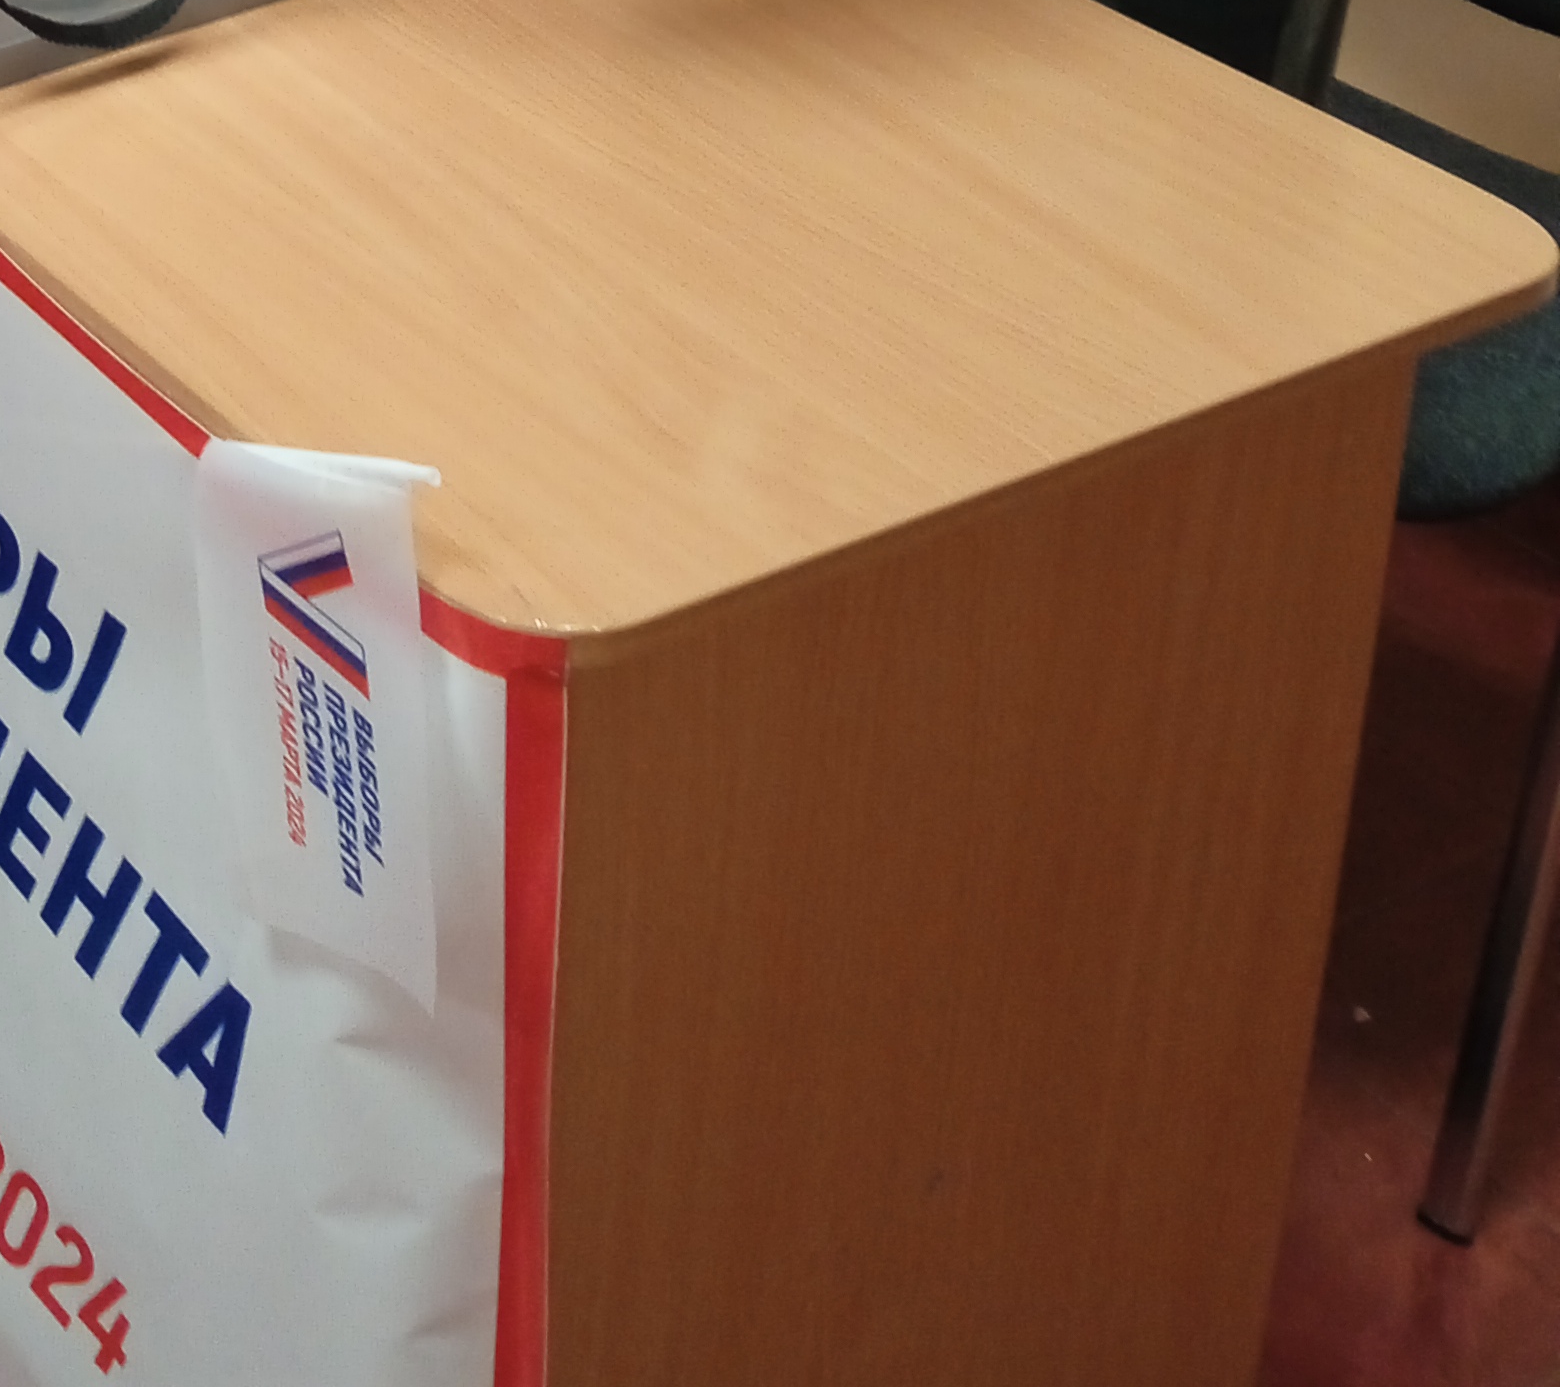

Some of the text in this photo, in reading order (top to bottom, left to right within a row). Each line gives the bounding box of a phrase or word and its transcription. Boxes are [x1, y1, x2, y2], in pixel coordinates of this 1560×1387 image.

[276, 700, 302, 789] МАРТА
[293, 655, 329, 798] РОССИИ
[322, 679, 364, 898] ПРЕЗИДЕНТА
[351, 705, 385, 869] ВЫБОРЫ
[283, 783, 307, 848] 2024
